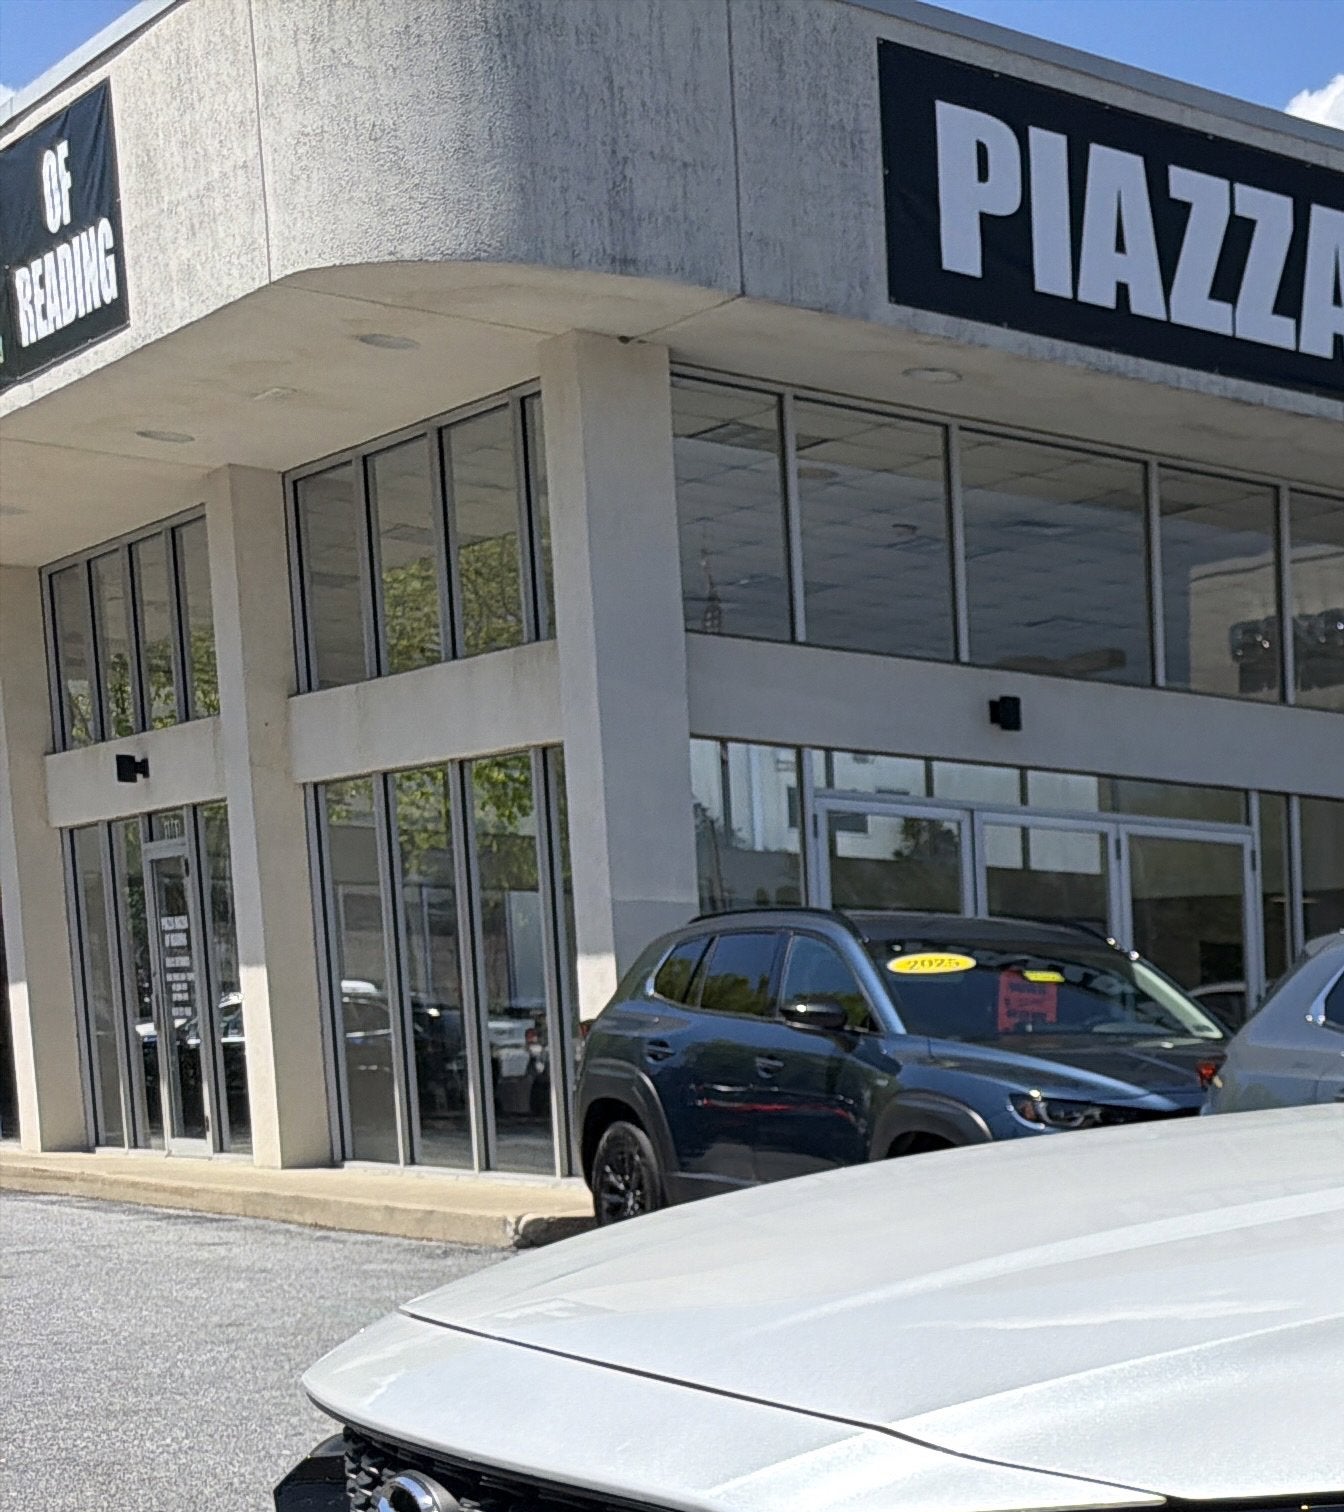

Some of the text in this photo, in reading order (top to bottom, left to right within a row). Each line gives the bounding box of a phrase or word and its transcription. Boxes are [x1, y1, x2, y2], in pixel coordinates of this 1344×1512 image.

[42, 139, 72, 234] OF
[14, 217, 118, 348] READING
[906, 958, 961, 972] 2025
